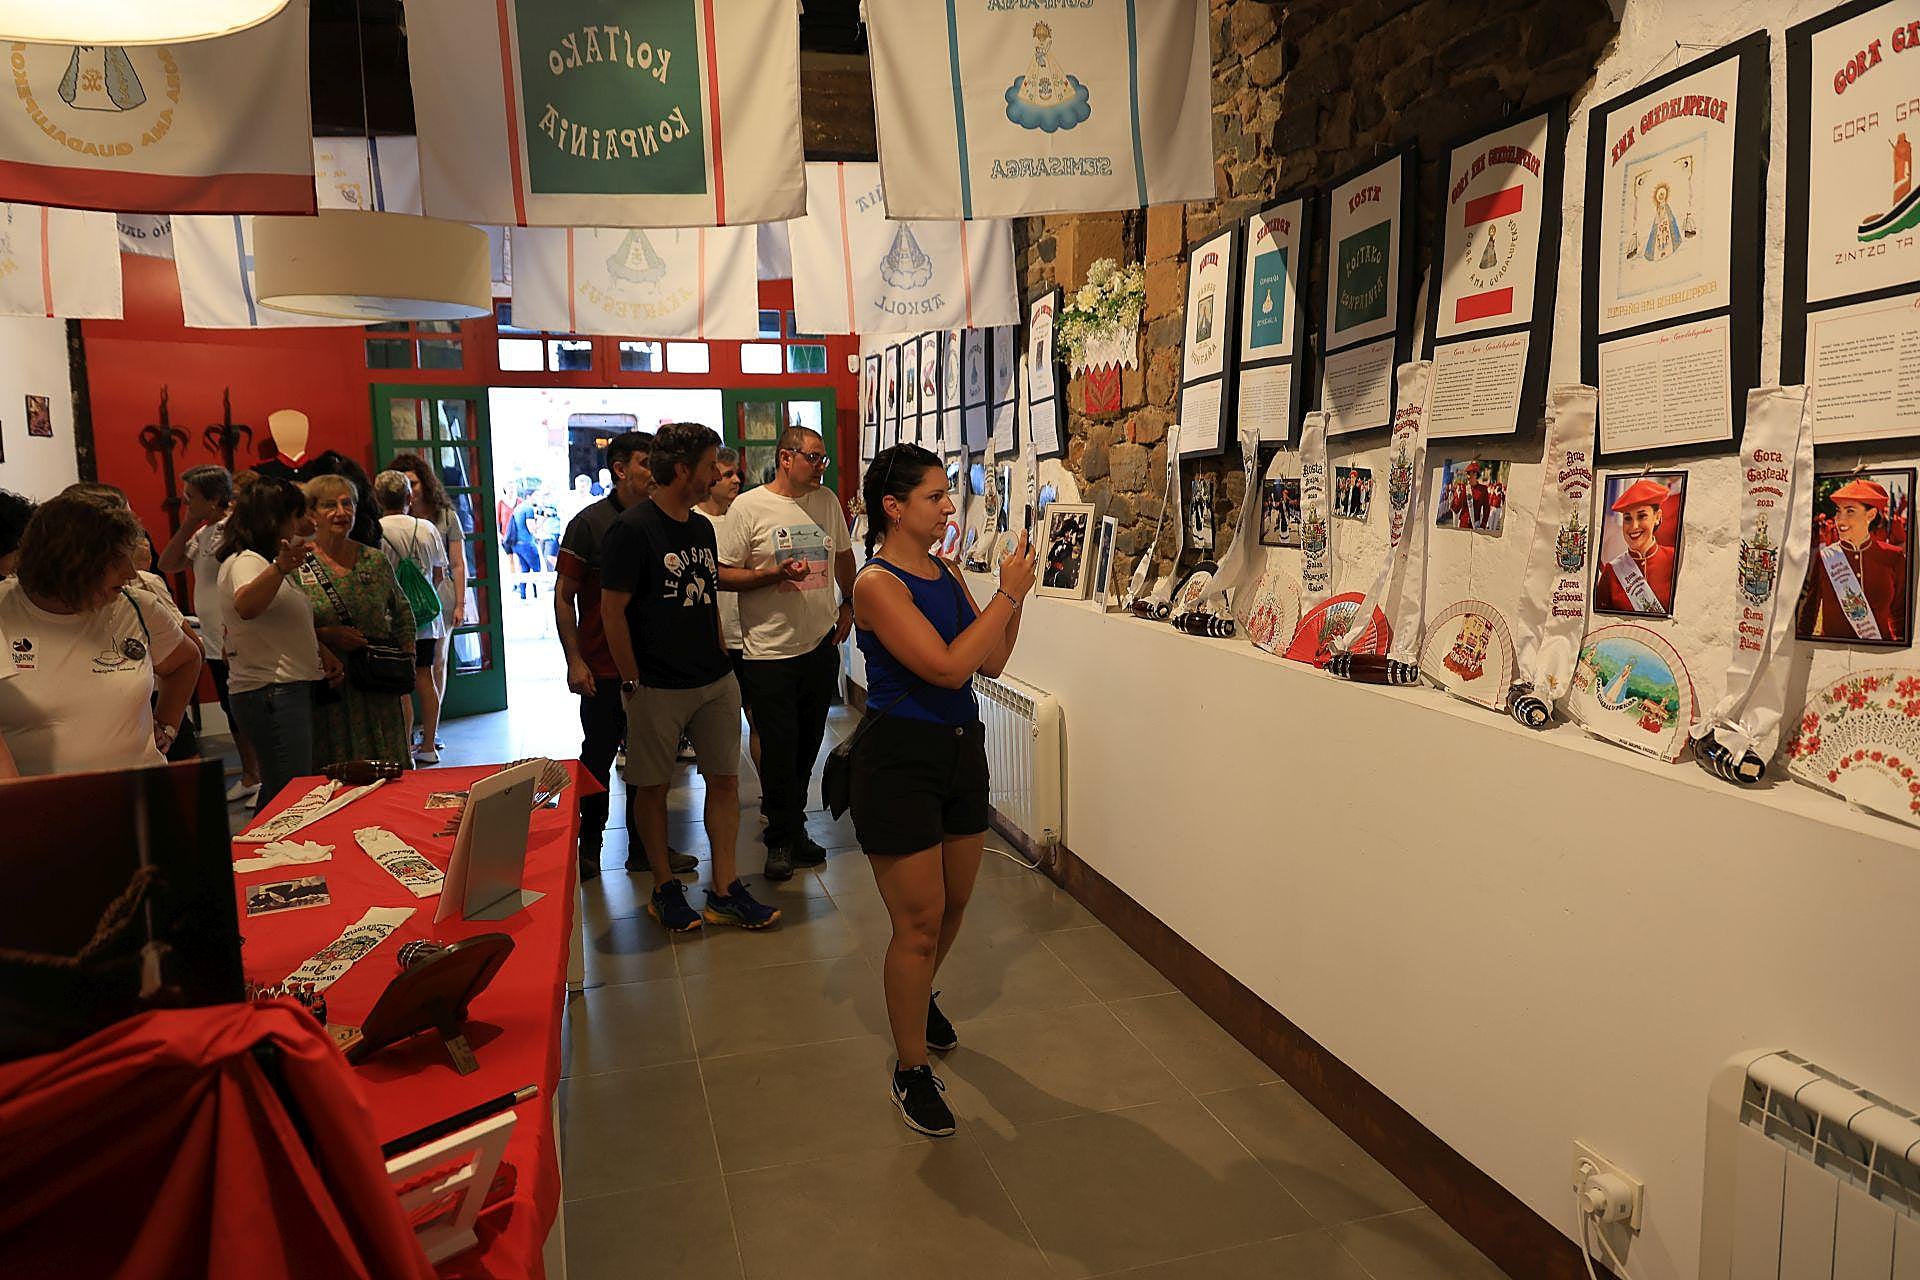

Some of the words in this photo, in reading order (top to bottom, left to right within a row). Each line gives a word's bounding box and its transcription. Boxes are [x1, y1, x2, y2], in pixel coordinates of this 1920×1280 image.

[1833, 38, 1882, 95] GORA
[1833, 112, 1879, 142] GORA
[1611, 125, 1636, 168] AMA
[1348, 185, 1382, 215] KOSTA
[1834, 243, 1886, 265] ZINTZO
[1567, 451, 1585, 467] Ama
[1753, 449, 1783, 463] Gora
[1756, 499, 1774, 507] 2023
[663, 579, 679, 598] LE
